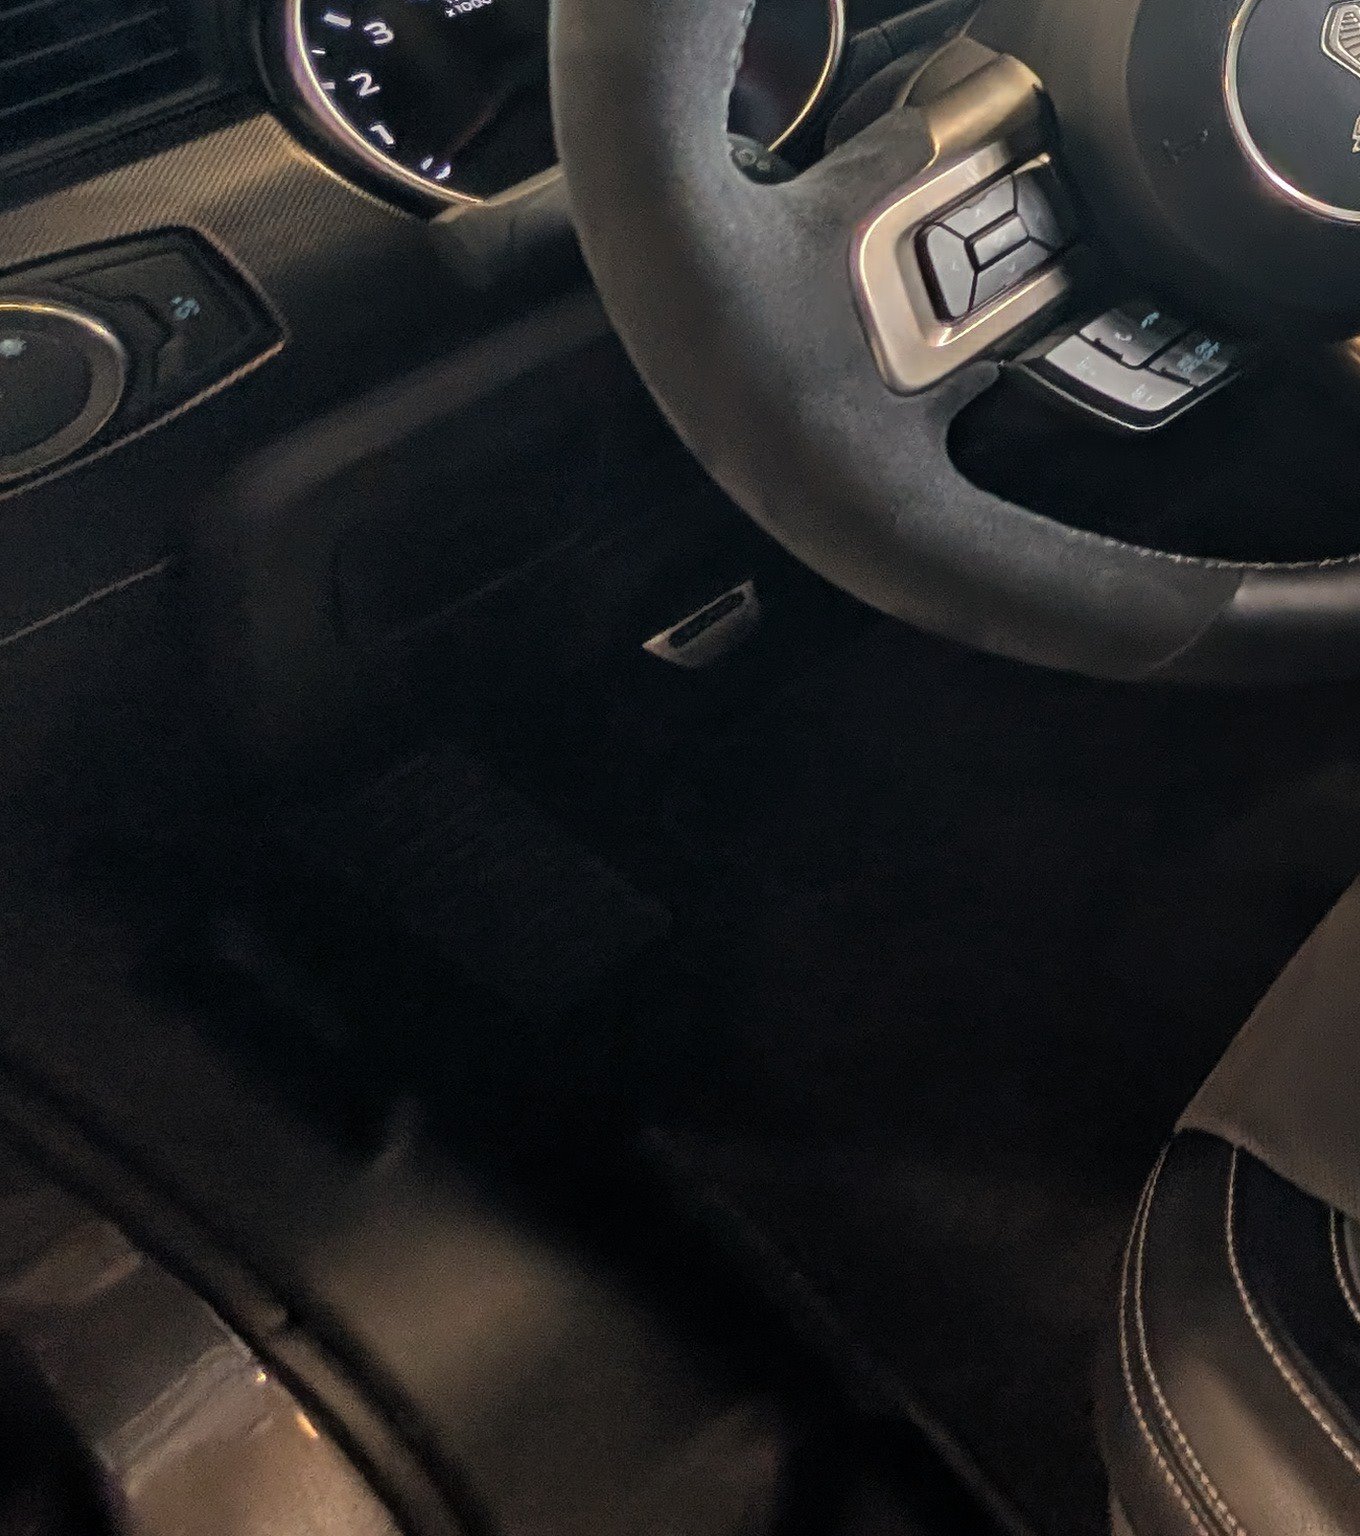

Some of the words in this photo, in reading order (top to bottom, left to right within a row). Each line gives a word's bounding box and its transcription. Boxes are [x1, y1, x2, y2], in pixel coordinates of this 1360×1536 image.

[363, 21, 394, 45] 3
[348, 72, 381, 96] 2
[370, 124, 395, 145] 1
